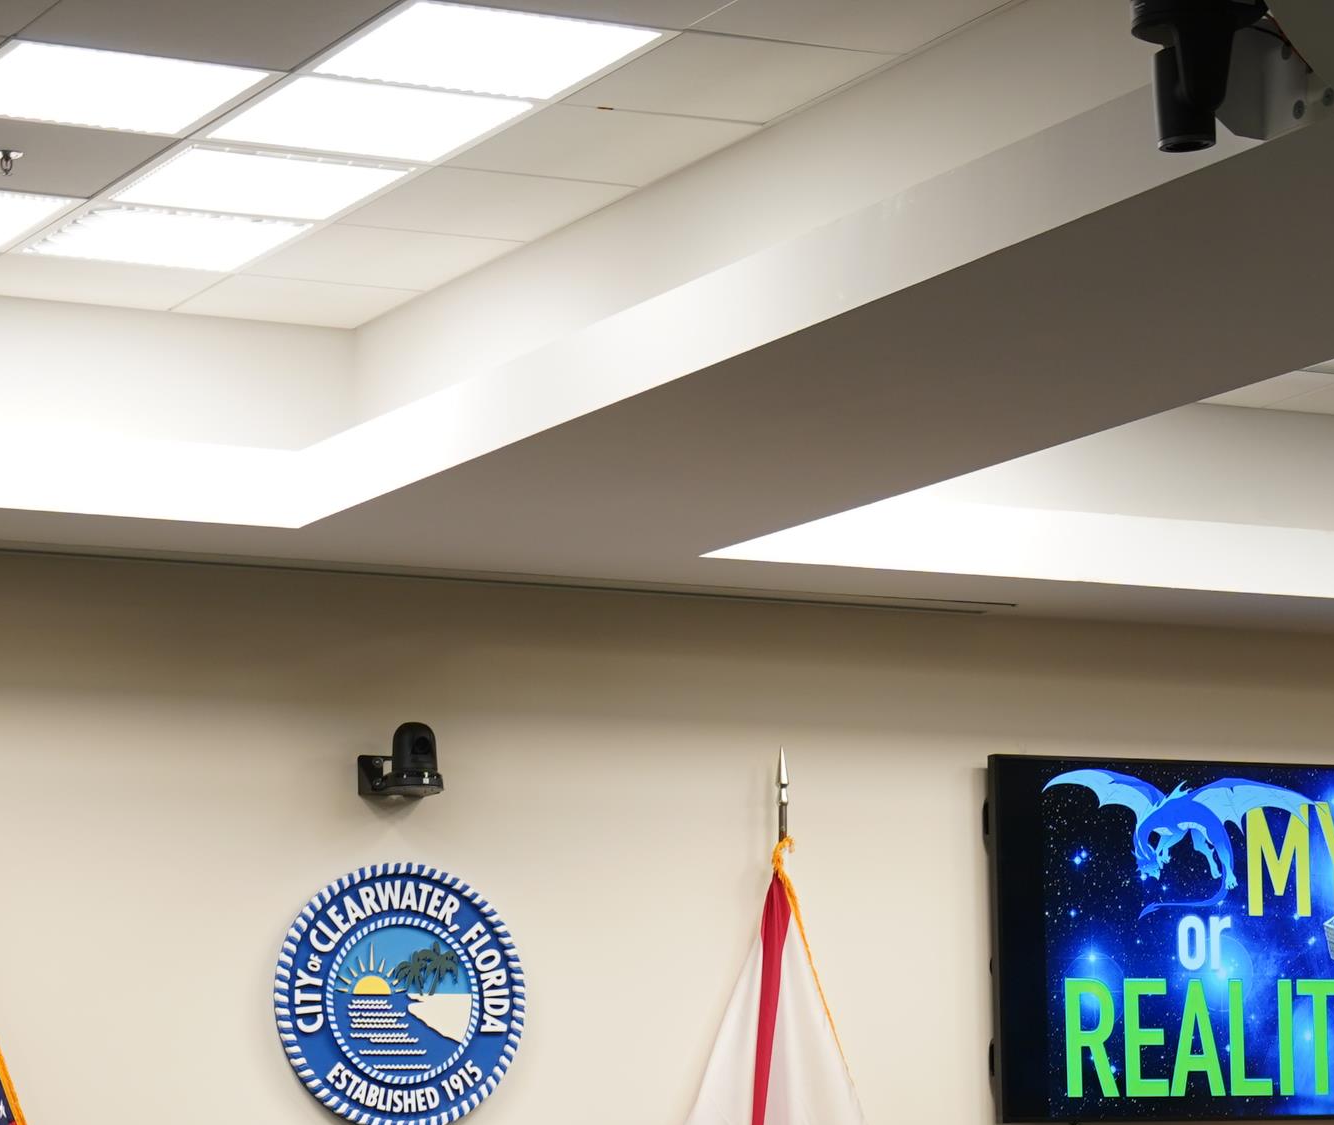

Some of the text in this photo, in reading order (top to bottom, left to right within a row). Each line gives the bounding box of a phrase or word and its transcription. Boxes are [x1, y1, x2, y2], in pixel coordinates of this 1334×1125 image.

[294, 880, 511, 1033] CITY OF CLEARWATER, FLORIDA
[1178, 914, 1231, 971] or
[325, 1060, 483, 1113] ESTABLISHED 1915
